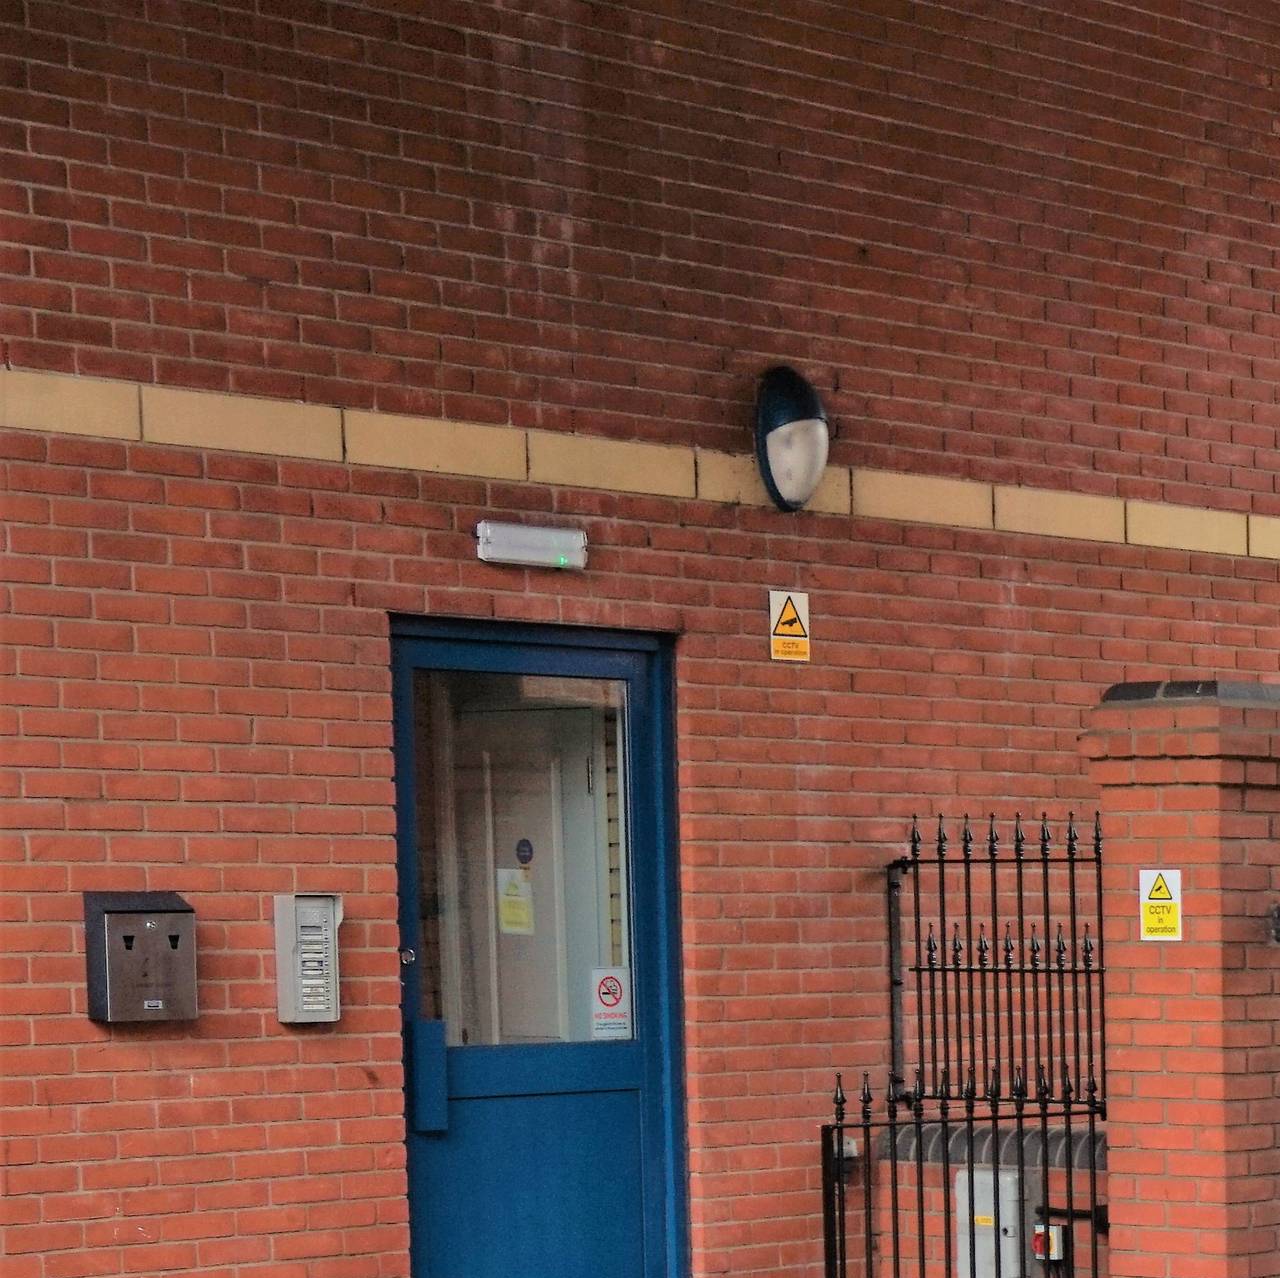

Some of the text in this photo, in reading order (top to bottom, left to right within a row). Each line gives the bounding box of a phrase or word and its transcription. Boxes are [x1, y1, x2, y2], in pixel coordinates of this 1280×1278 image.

[1149, 905, 1172, 915] CCTV
[1158, 916, 1164, 924] in
[1146, 926, 1176, 934] operation
